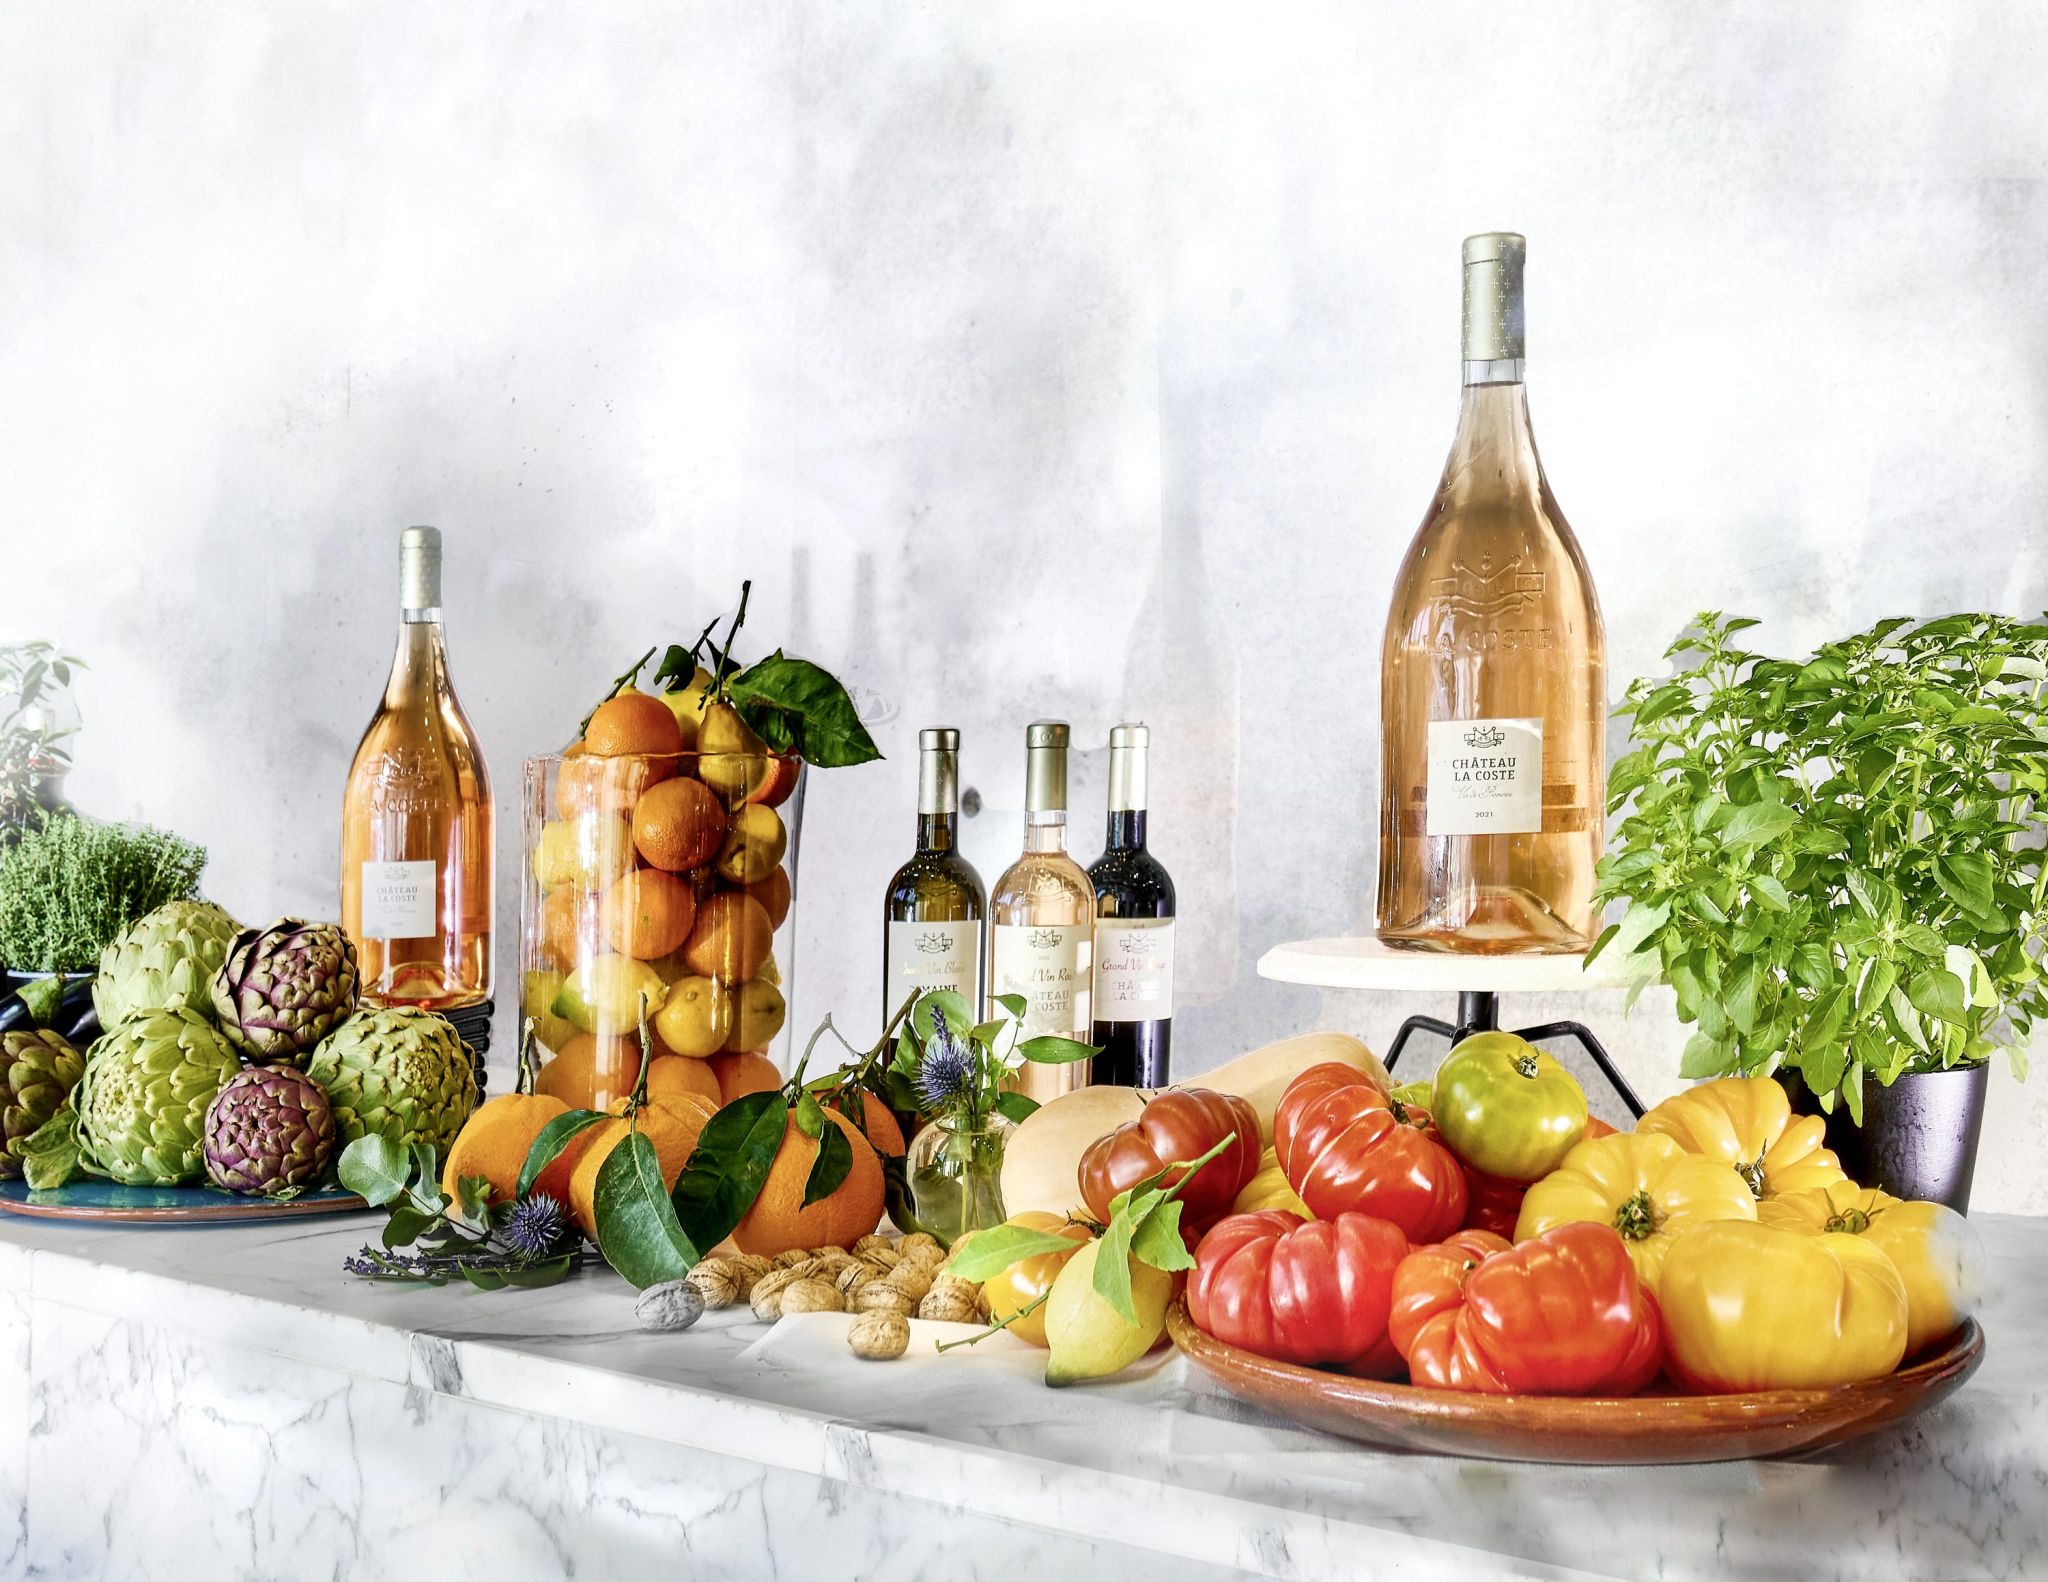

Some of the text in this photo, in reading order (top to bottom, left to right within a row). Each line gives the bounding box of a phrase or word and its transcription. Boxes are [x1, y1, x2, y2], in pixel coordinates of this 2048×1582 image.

[1467, 629, 1552, 652] COSTE
[1452, 757, 1516, 769] CHÂTEAU
[1454, 770, 1515, 782] LA COSTE
[377, 886, 418, 894] CHÂTEAU
[378, 895, 417, 903] LA COSTE
[1101, 957, 1129, 973] Grand
[1038, 968, 1055, 982] Vin
[1035, 1000, 1069, 1011] COSTE
